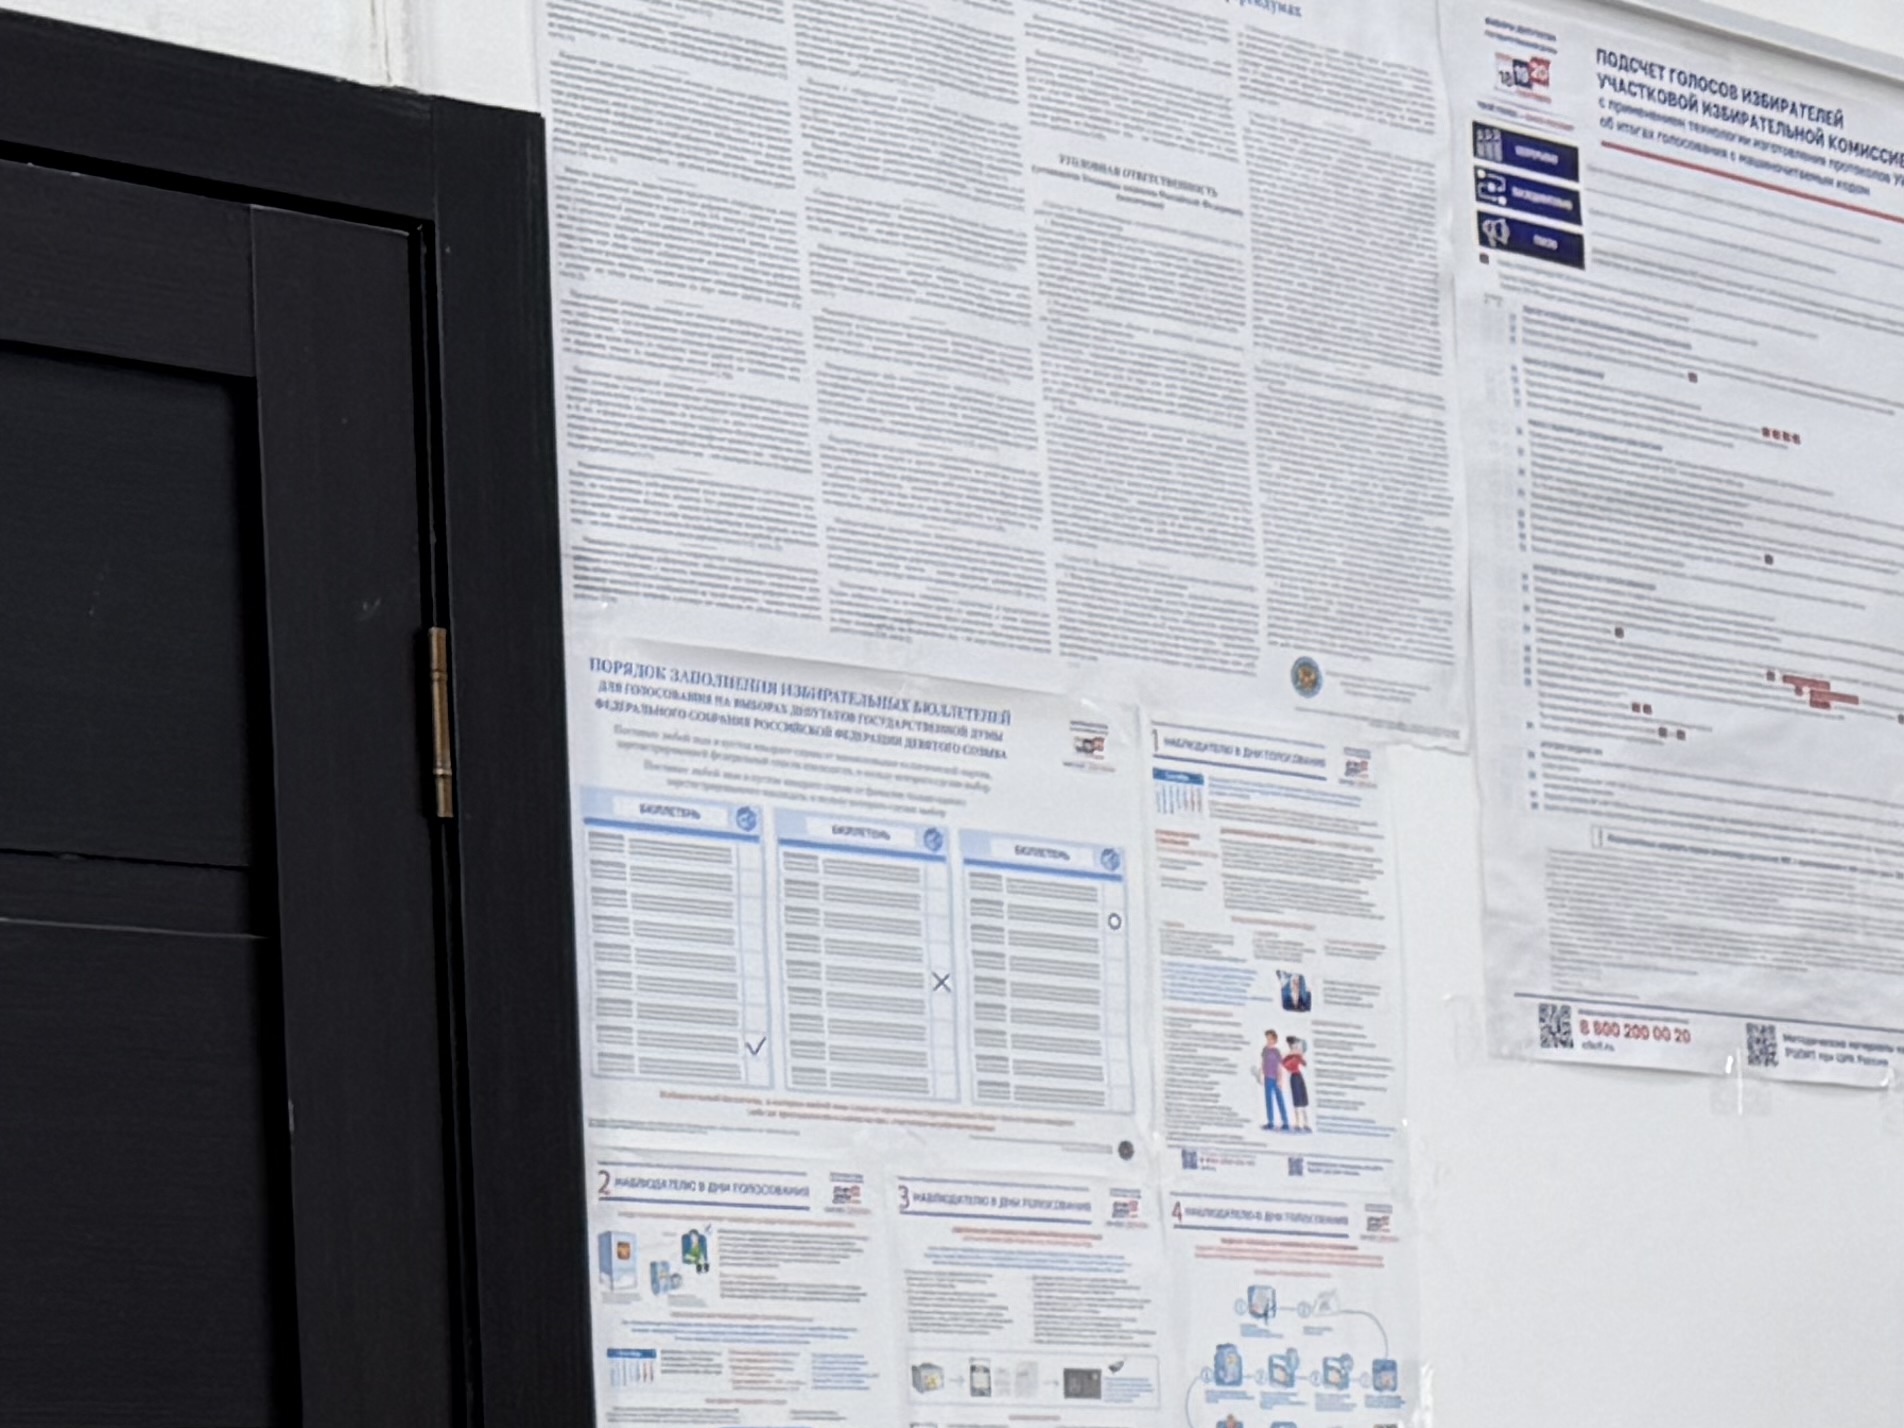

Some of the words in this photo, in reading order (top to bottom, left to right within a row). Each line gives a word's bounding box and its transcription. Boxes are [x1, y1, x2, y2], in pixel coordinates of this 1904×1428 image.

[1596, 48, 1666, 81] ПОДСЧЕТ
[1670, 68, 1738, 100] ГОЛОСОВ
[1741, 88, 1844, 129] ИЗБИРАТЕЛЕЙ
[1597, 73, 1699, 114] УЧАСТКОВОЙ
[1702, 101, 1825, 148] ИЗБИРАТЕЛЬНОЙ
[590, 657, 666, 680] ПОРЯДОК
[670, 668, 777, 693] ЗАПОЛНЕНИЯ
[781, 683, 910, 712] ИЗБИРАТЕЛЬНЫХ
[913, 701, 1011, 725] БЮЛЛЕТЕНЕЙ
[625, 684, 712, 705] ГОЛОСОВАНИЯ
[1579, 1019, 1590, 1035] 8
[1623, 1023, 1649, 1040] 200
[1652, 1026, 1671, 1042] 00
[1673, 1028, 1691, 1044] 20
[598, 1170, 611, 1195] 2
[899, 1185, 910, 1209] 3
[1172, 1201, 1183, 1222] 4
